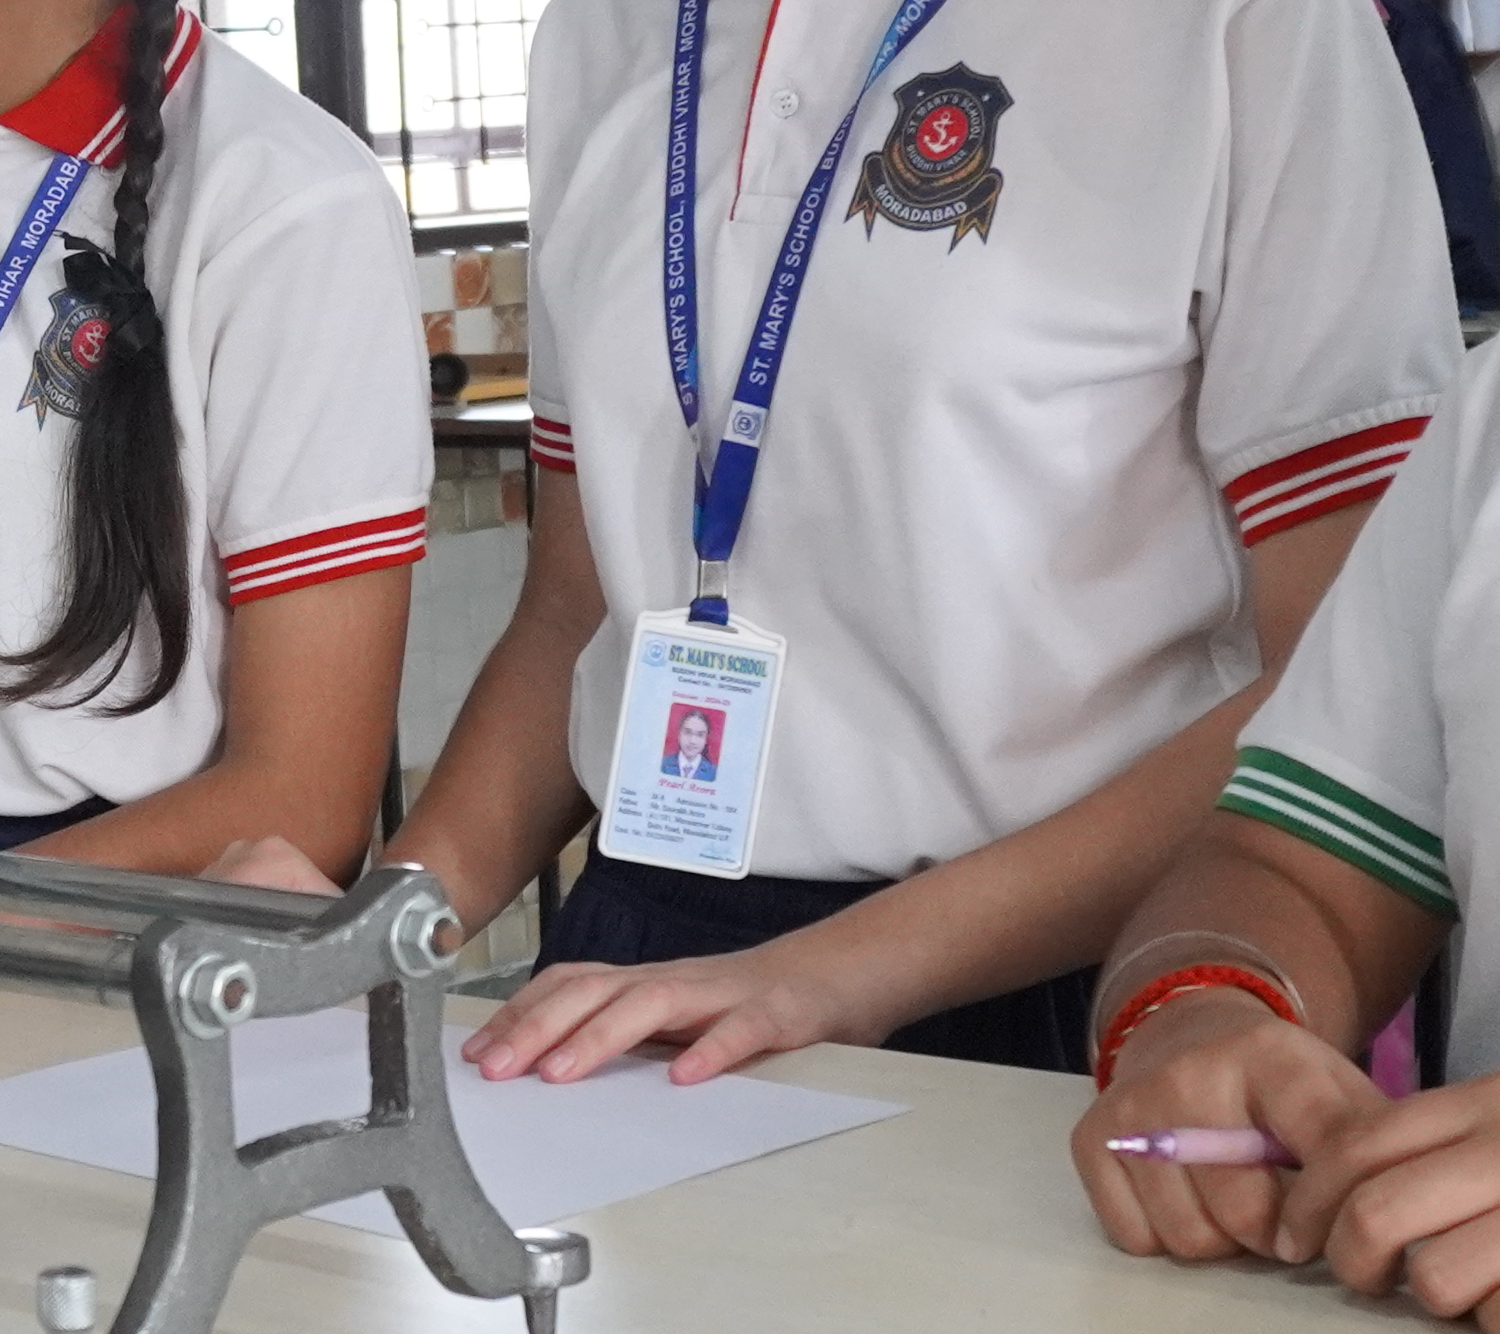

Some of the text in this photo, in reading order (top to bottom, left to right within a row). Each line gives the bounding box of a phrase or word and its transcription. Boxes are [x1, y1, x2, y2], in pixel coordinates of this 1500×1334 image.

[675, 54, 695, 116] VIHAR,
[669, 123, 688, 197] BUDDHI
[20, 156, 82, 250] MORADAB
[785, 177, 829, 268] SCHOOL,
[875, 183, 968, 223] MORADABAD
[668, 199, 686, 290] SCHOOL,
[669, 293, 688, 371] MARY'S
[759, 271, 795, 351] MARY'S
[749, 357, 771, 386] ST.
[669, 644, 768, 678] ST. MARY'S SCHOOL
